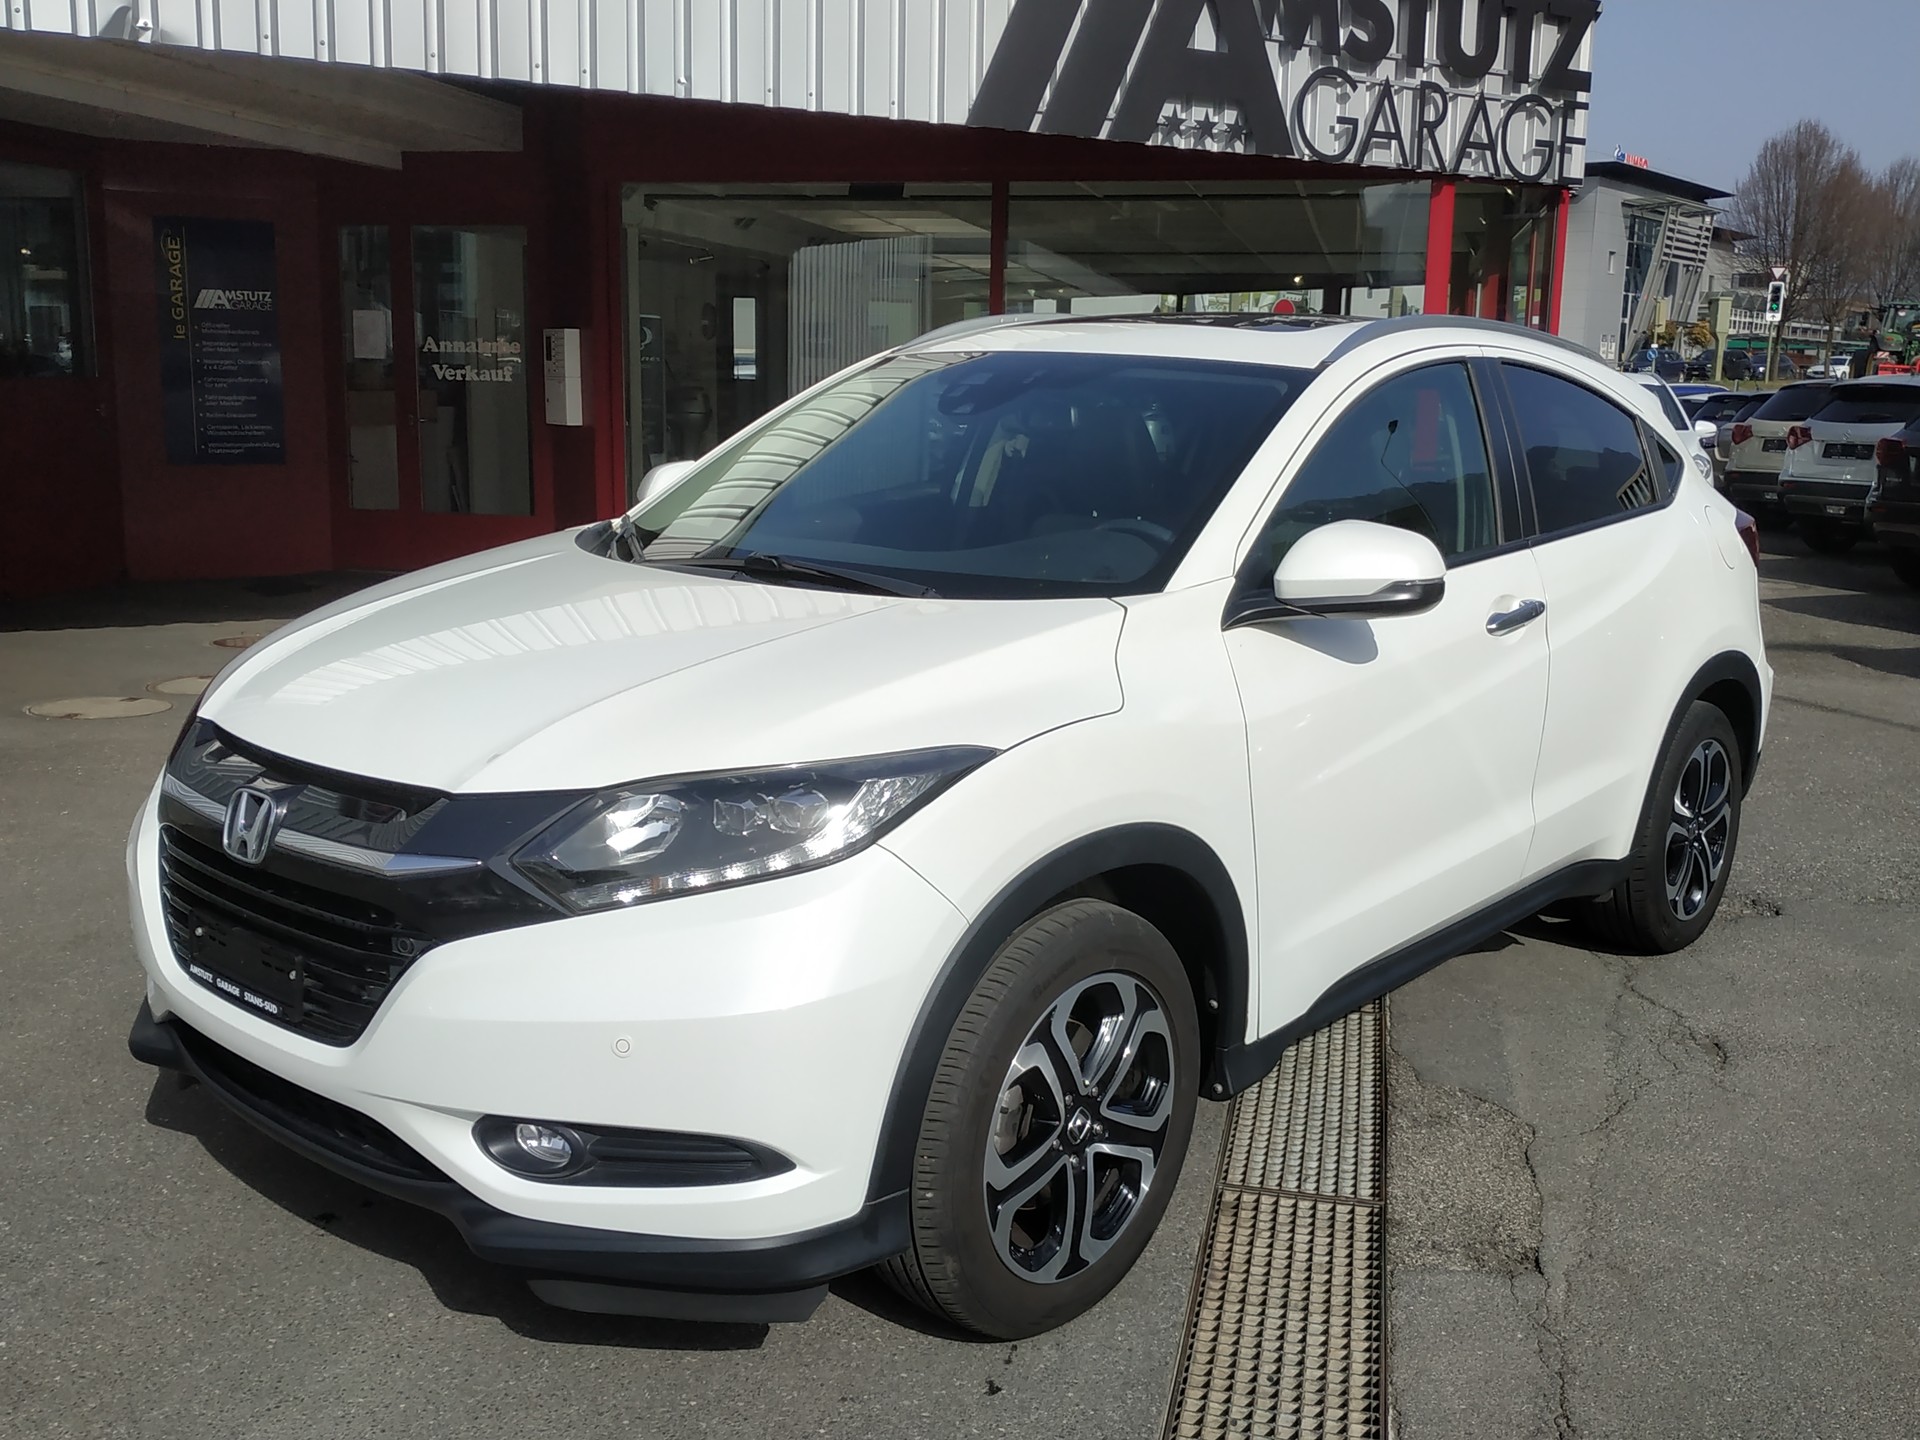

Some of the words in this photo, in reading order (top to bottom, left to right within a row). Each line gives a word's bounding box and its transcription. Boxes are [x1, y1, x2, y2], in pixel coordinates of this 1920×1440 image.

[1296, 66, 1590, 186] GARAGE
[167, 236, 186, 320] GARAGE
[208, 288, 273, 308] AMSTUTZ
[229, 299, 273, 311] GARAGE
[432, 363, 513, 382] Verkauf
[189, 963, 214, 983] AMSTUTZ
[216, 978, 240, 997] GARAGE
